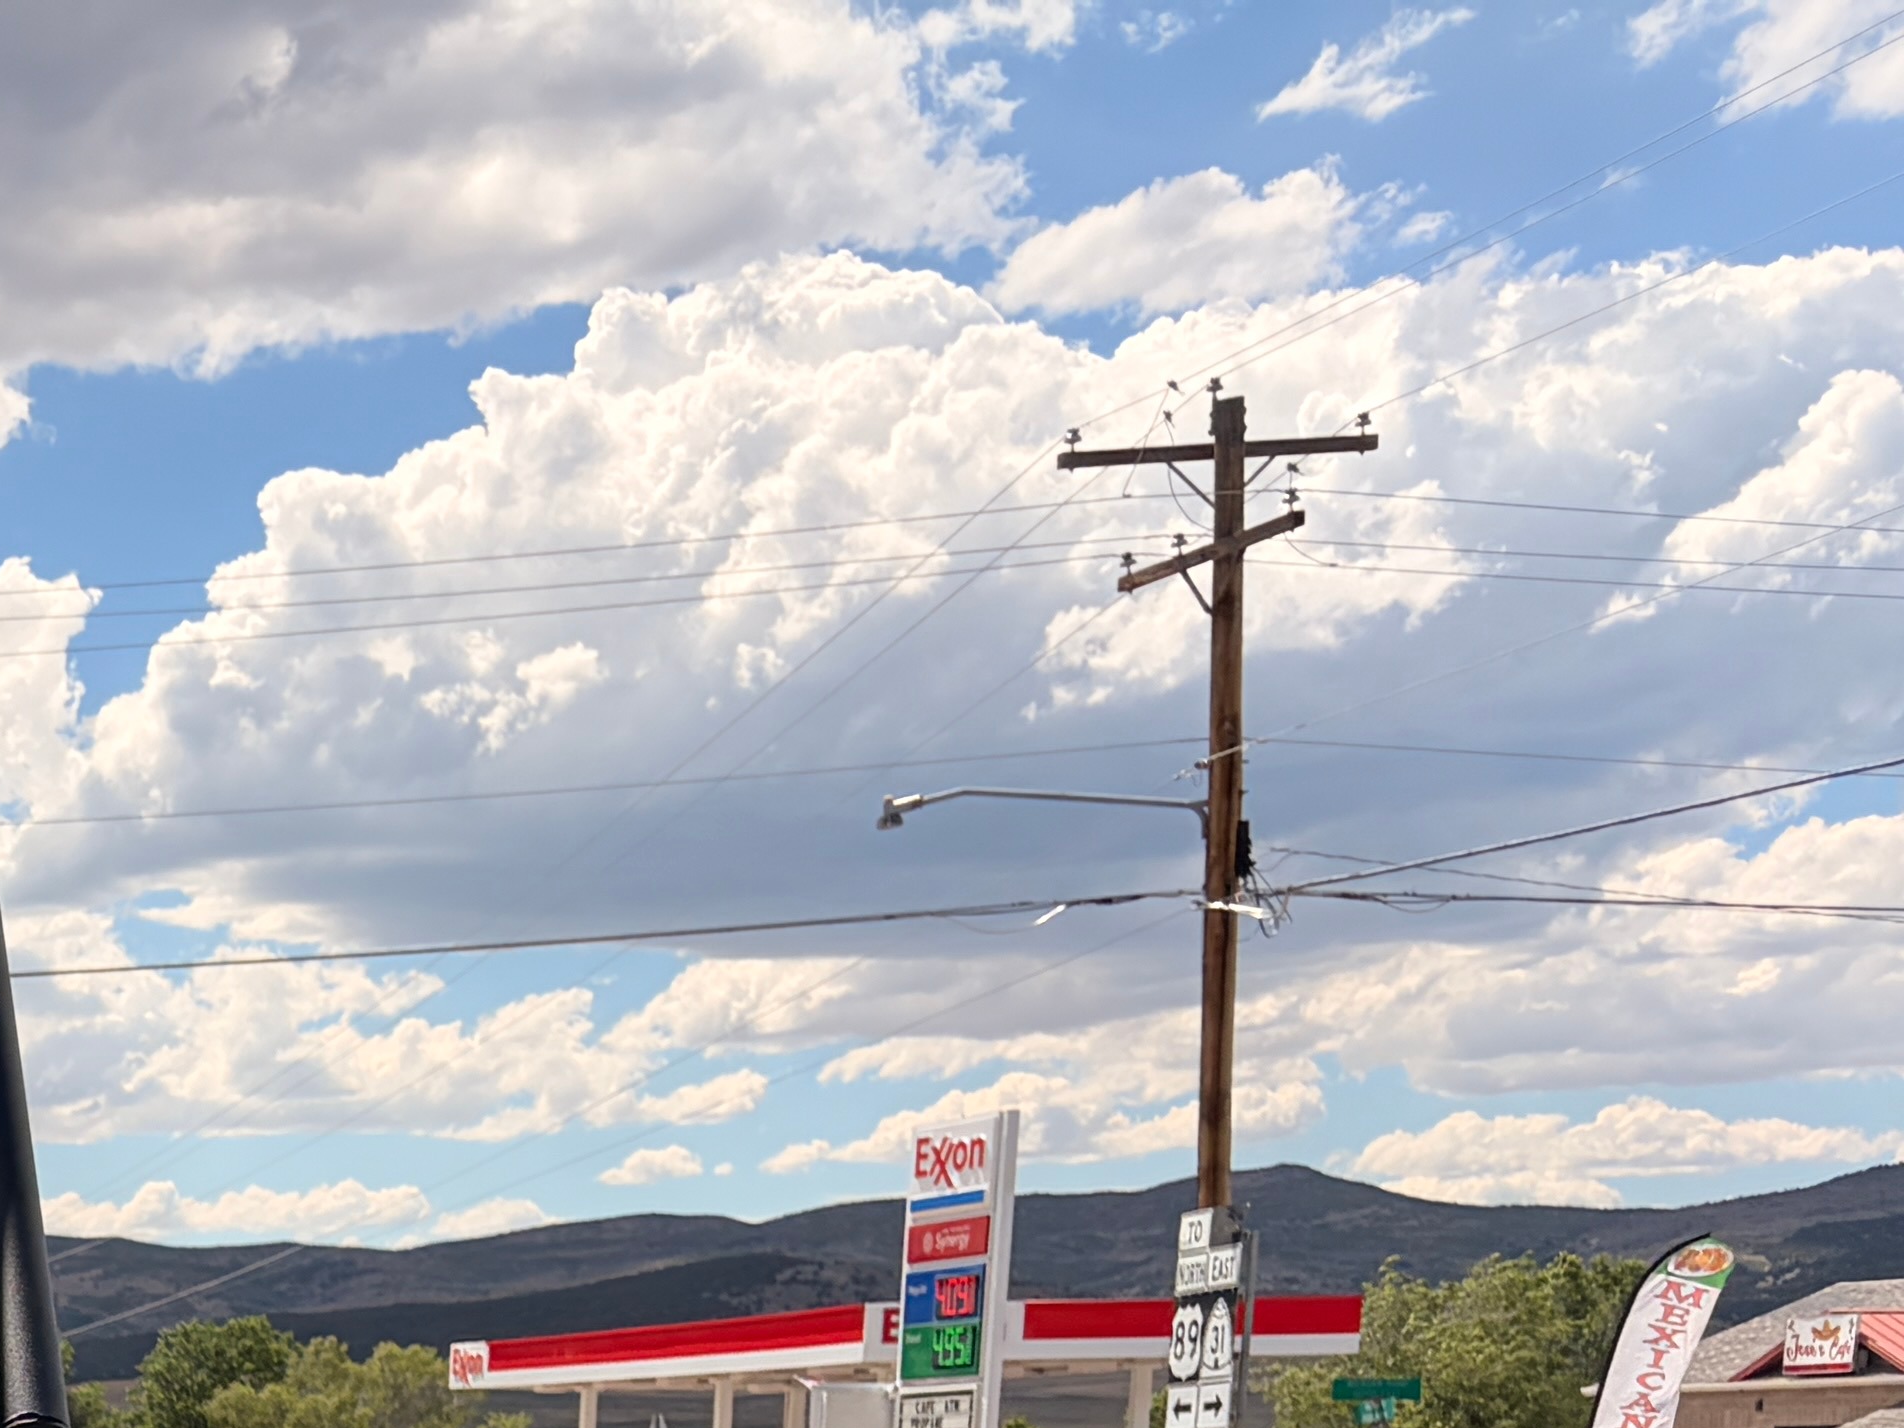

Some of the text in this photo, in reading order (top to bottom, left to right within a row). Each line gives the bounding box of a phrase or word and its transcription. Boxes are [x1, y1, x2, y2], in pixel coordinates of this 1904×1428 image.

[915, 1136, 986, 1189] Exxon
[1188, 1220, 1203, 1244] TO
[1212, 1256, 1234, 1281] EAST
[1174, 1320, 1200, 1361] 89
[1210, 1325, 1226, 1355] 31
[914, 1401, 936, 1415] CAFE
